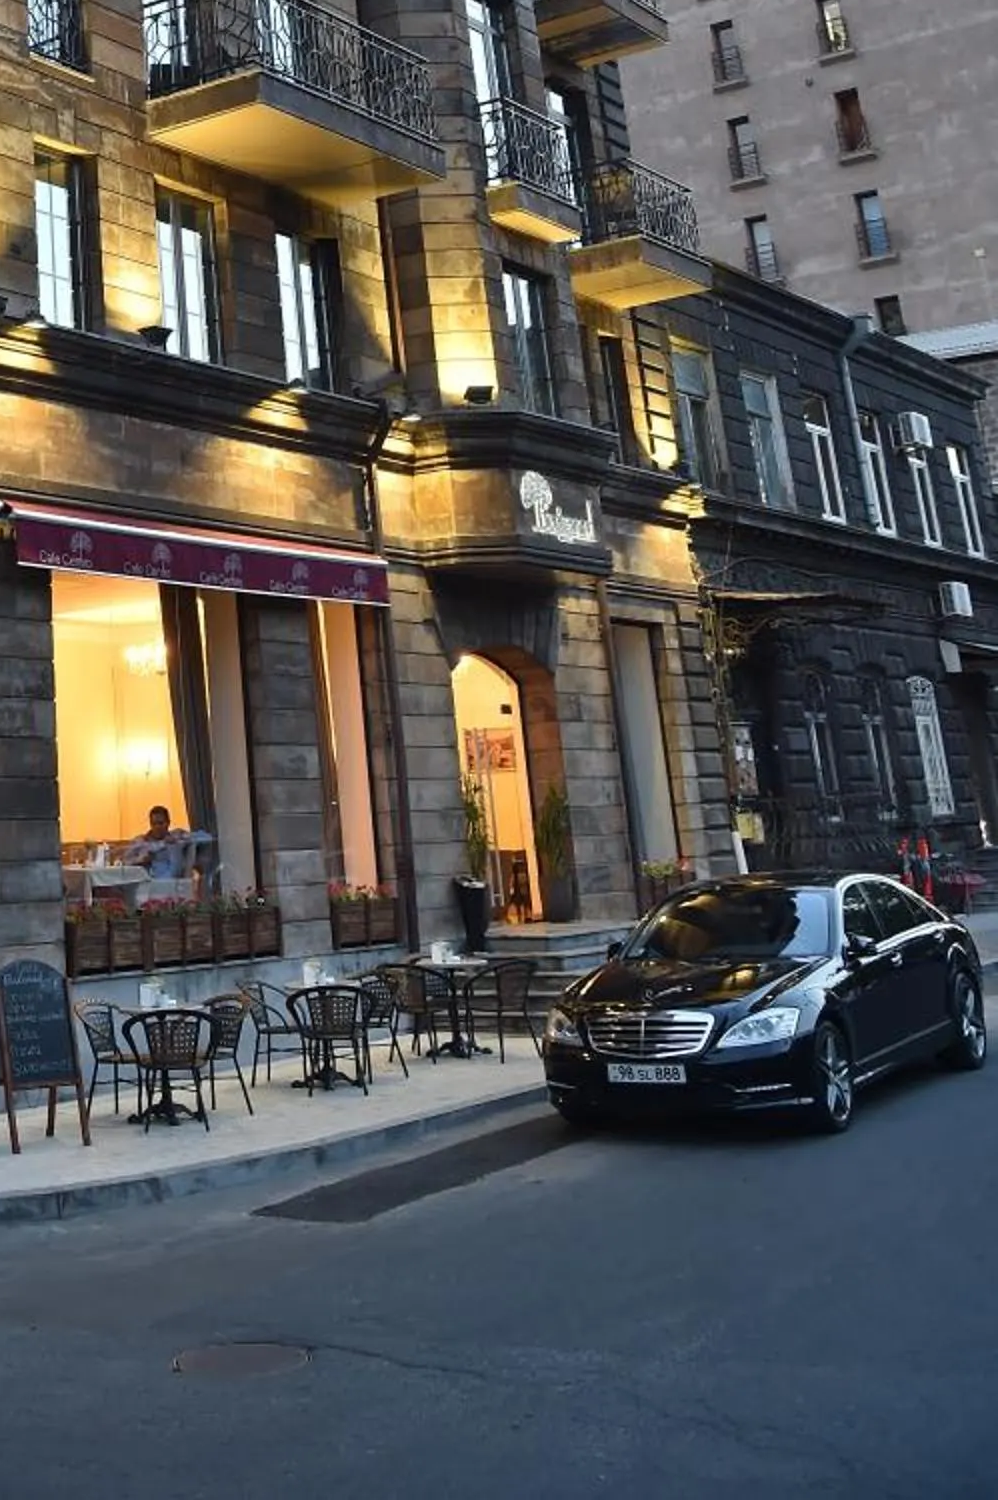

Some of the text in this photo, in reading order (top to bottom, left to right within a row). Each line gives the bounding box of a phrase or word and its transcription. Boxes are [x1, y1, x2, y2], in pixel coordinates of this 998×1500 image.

[617, 1065, 680, 1081] 98 SL 888
